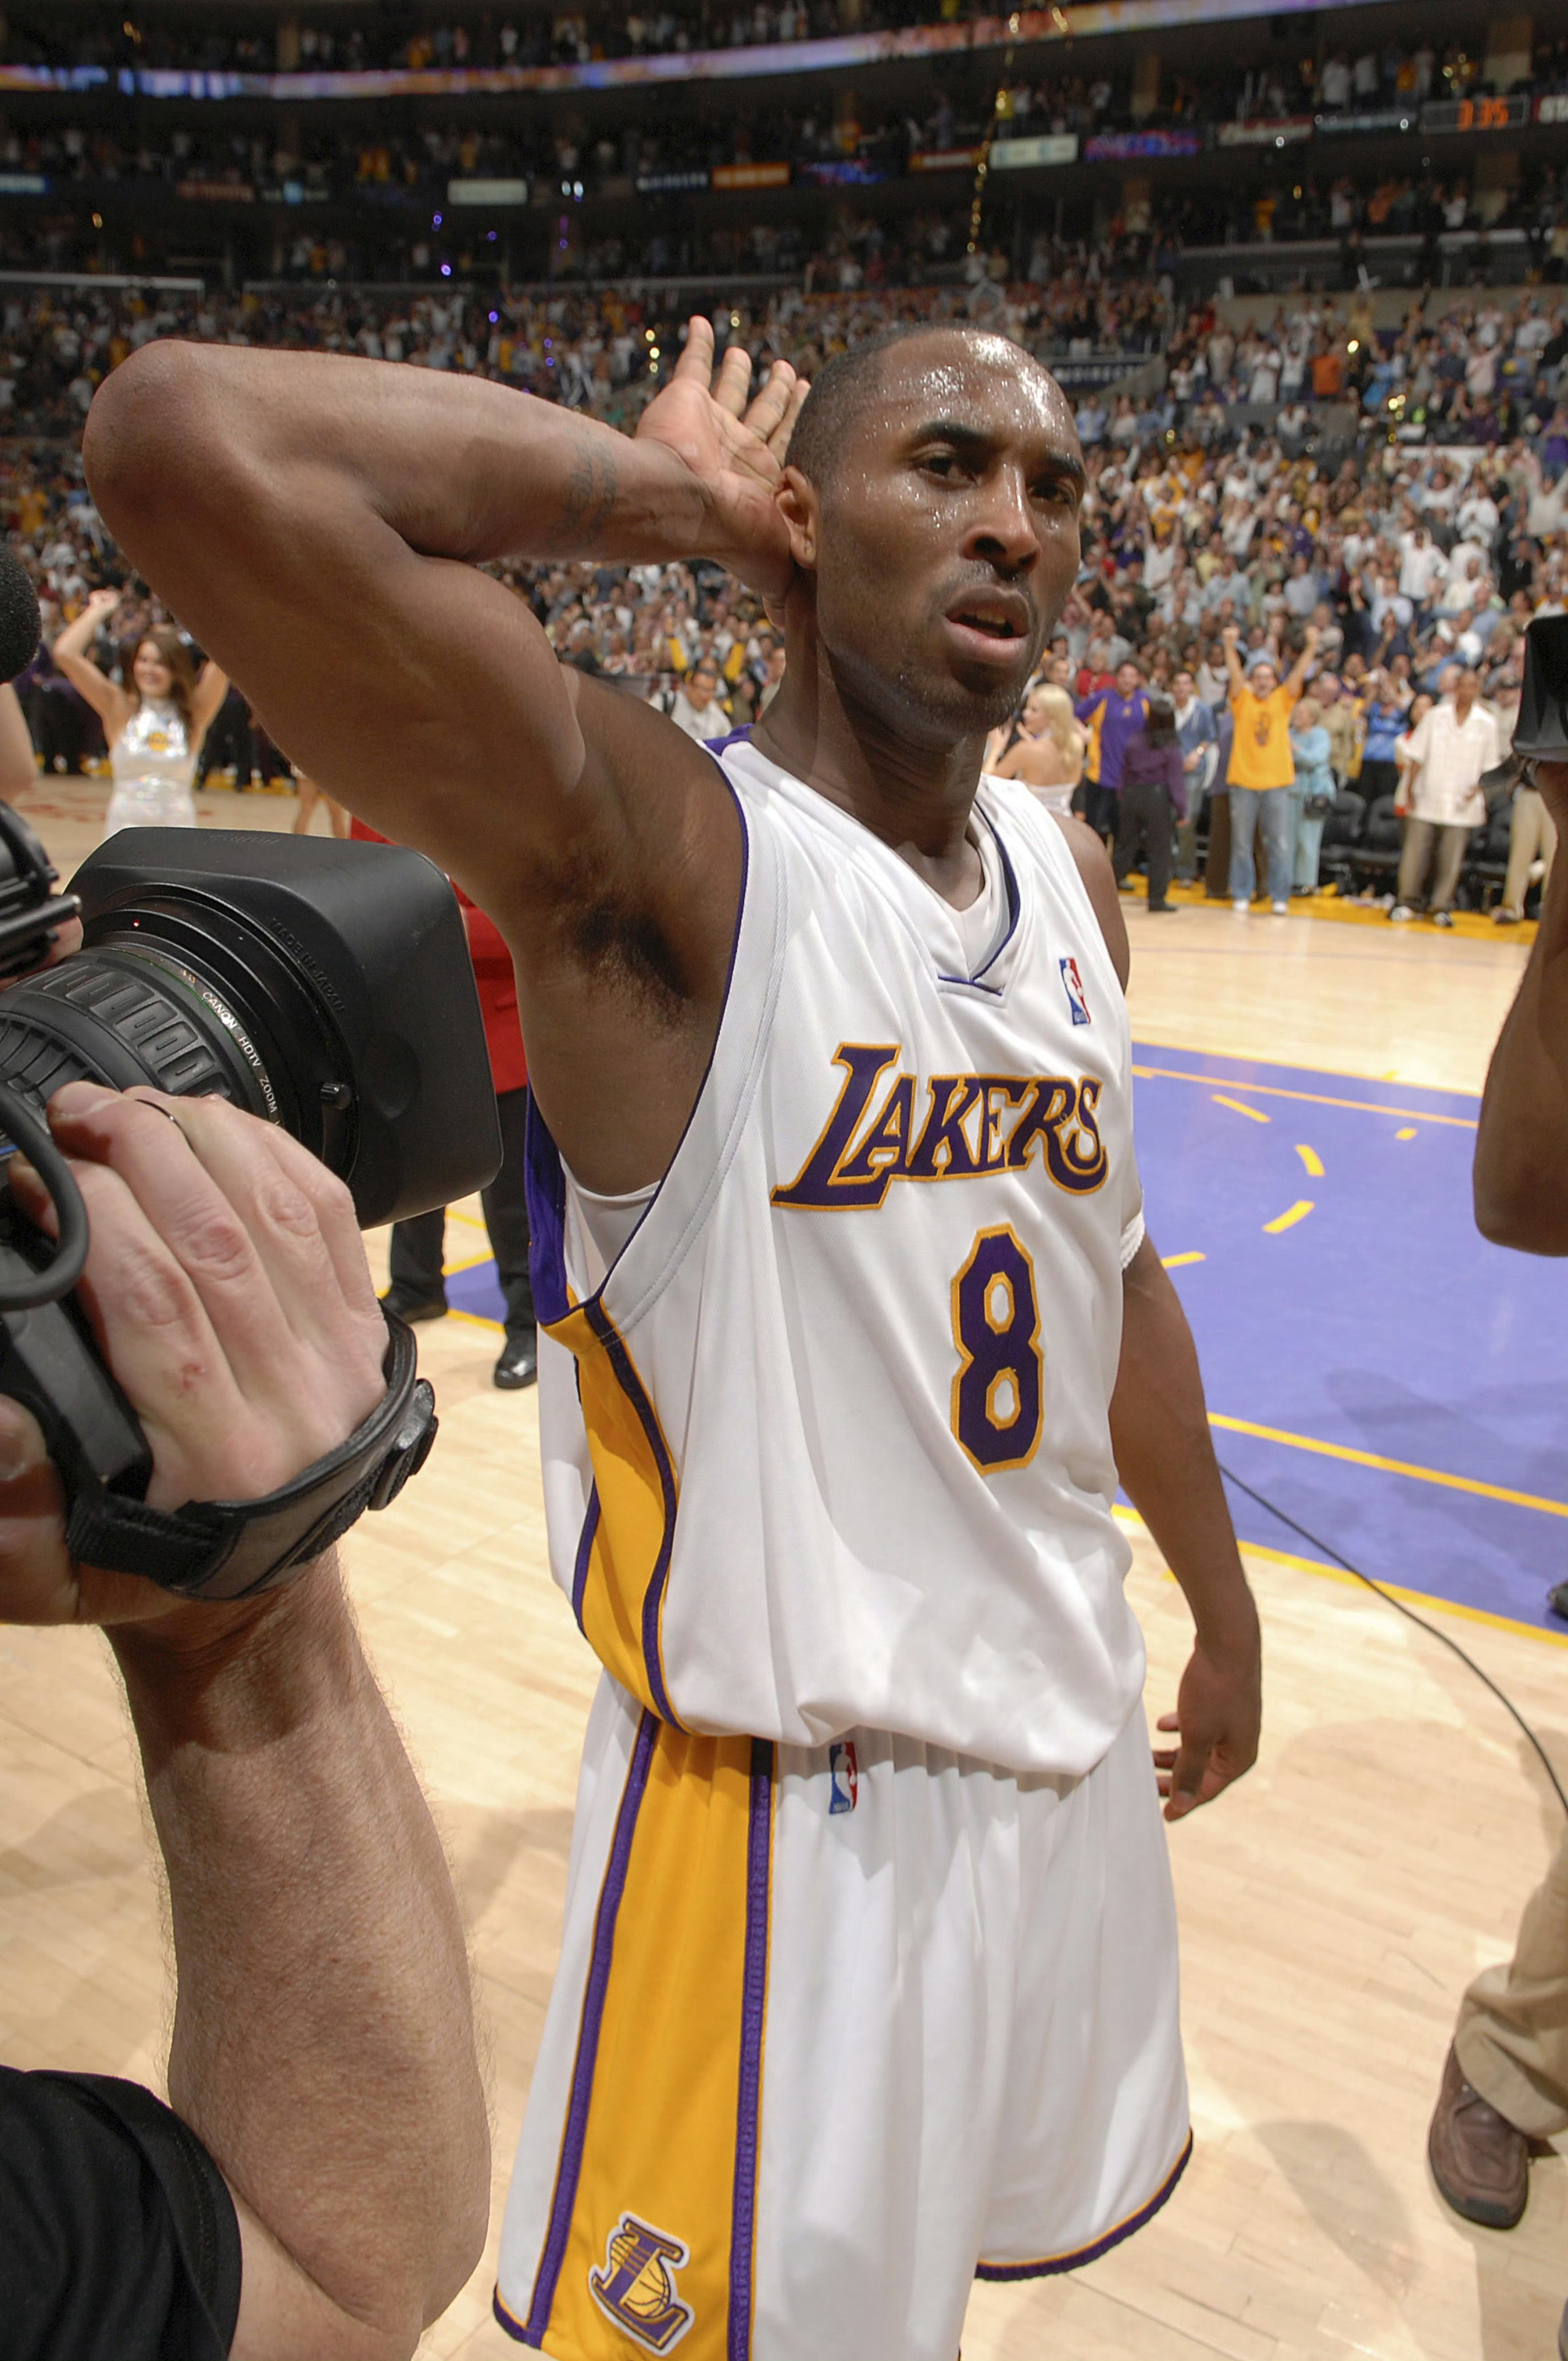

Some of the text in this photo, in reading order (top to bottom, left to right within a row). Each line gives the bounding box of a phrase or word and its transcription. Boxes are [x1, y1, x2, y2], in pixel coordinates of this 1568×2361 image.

[269, 916, 303, 953] MADE
[311, 969, 346, 1013] JAPAN
[202, 992, 277, 1113] CANON HDTV ZOOM
[770, 1042, 1108, 1210] LAKERS
[951, 1222, 1045, 1476] 8
